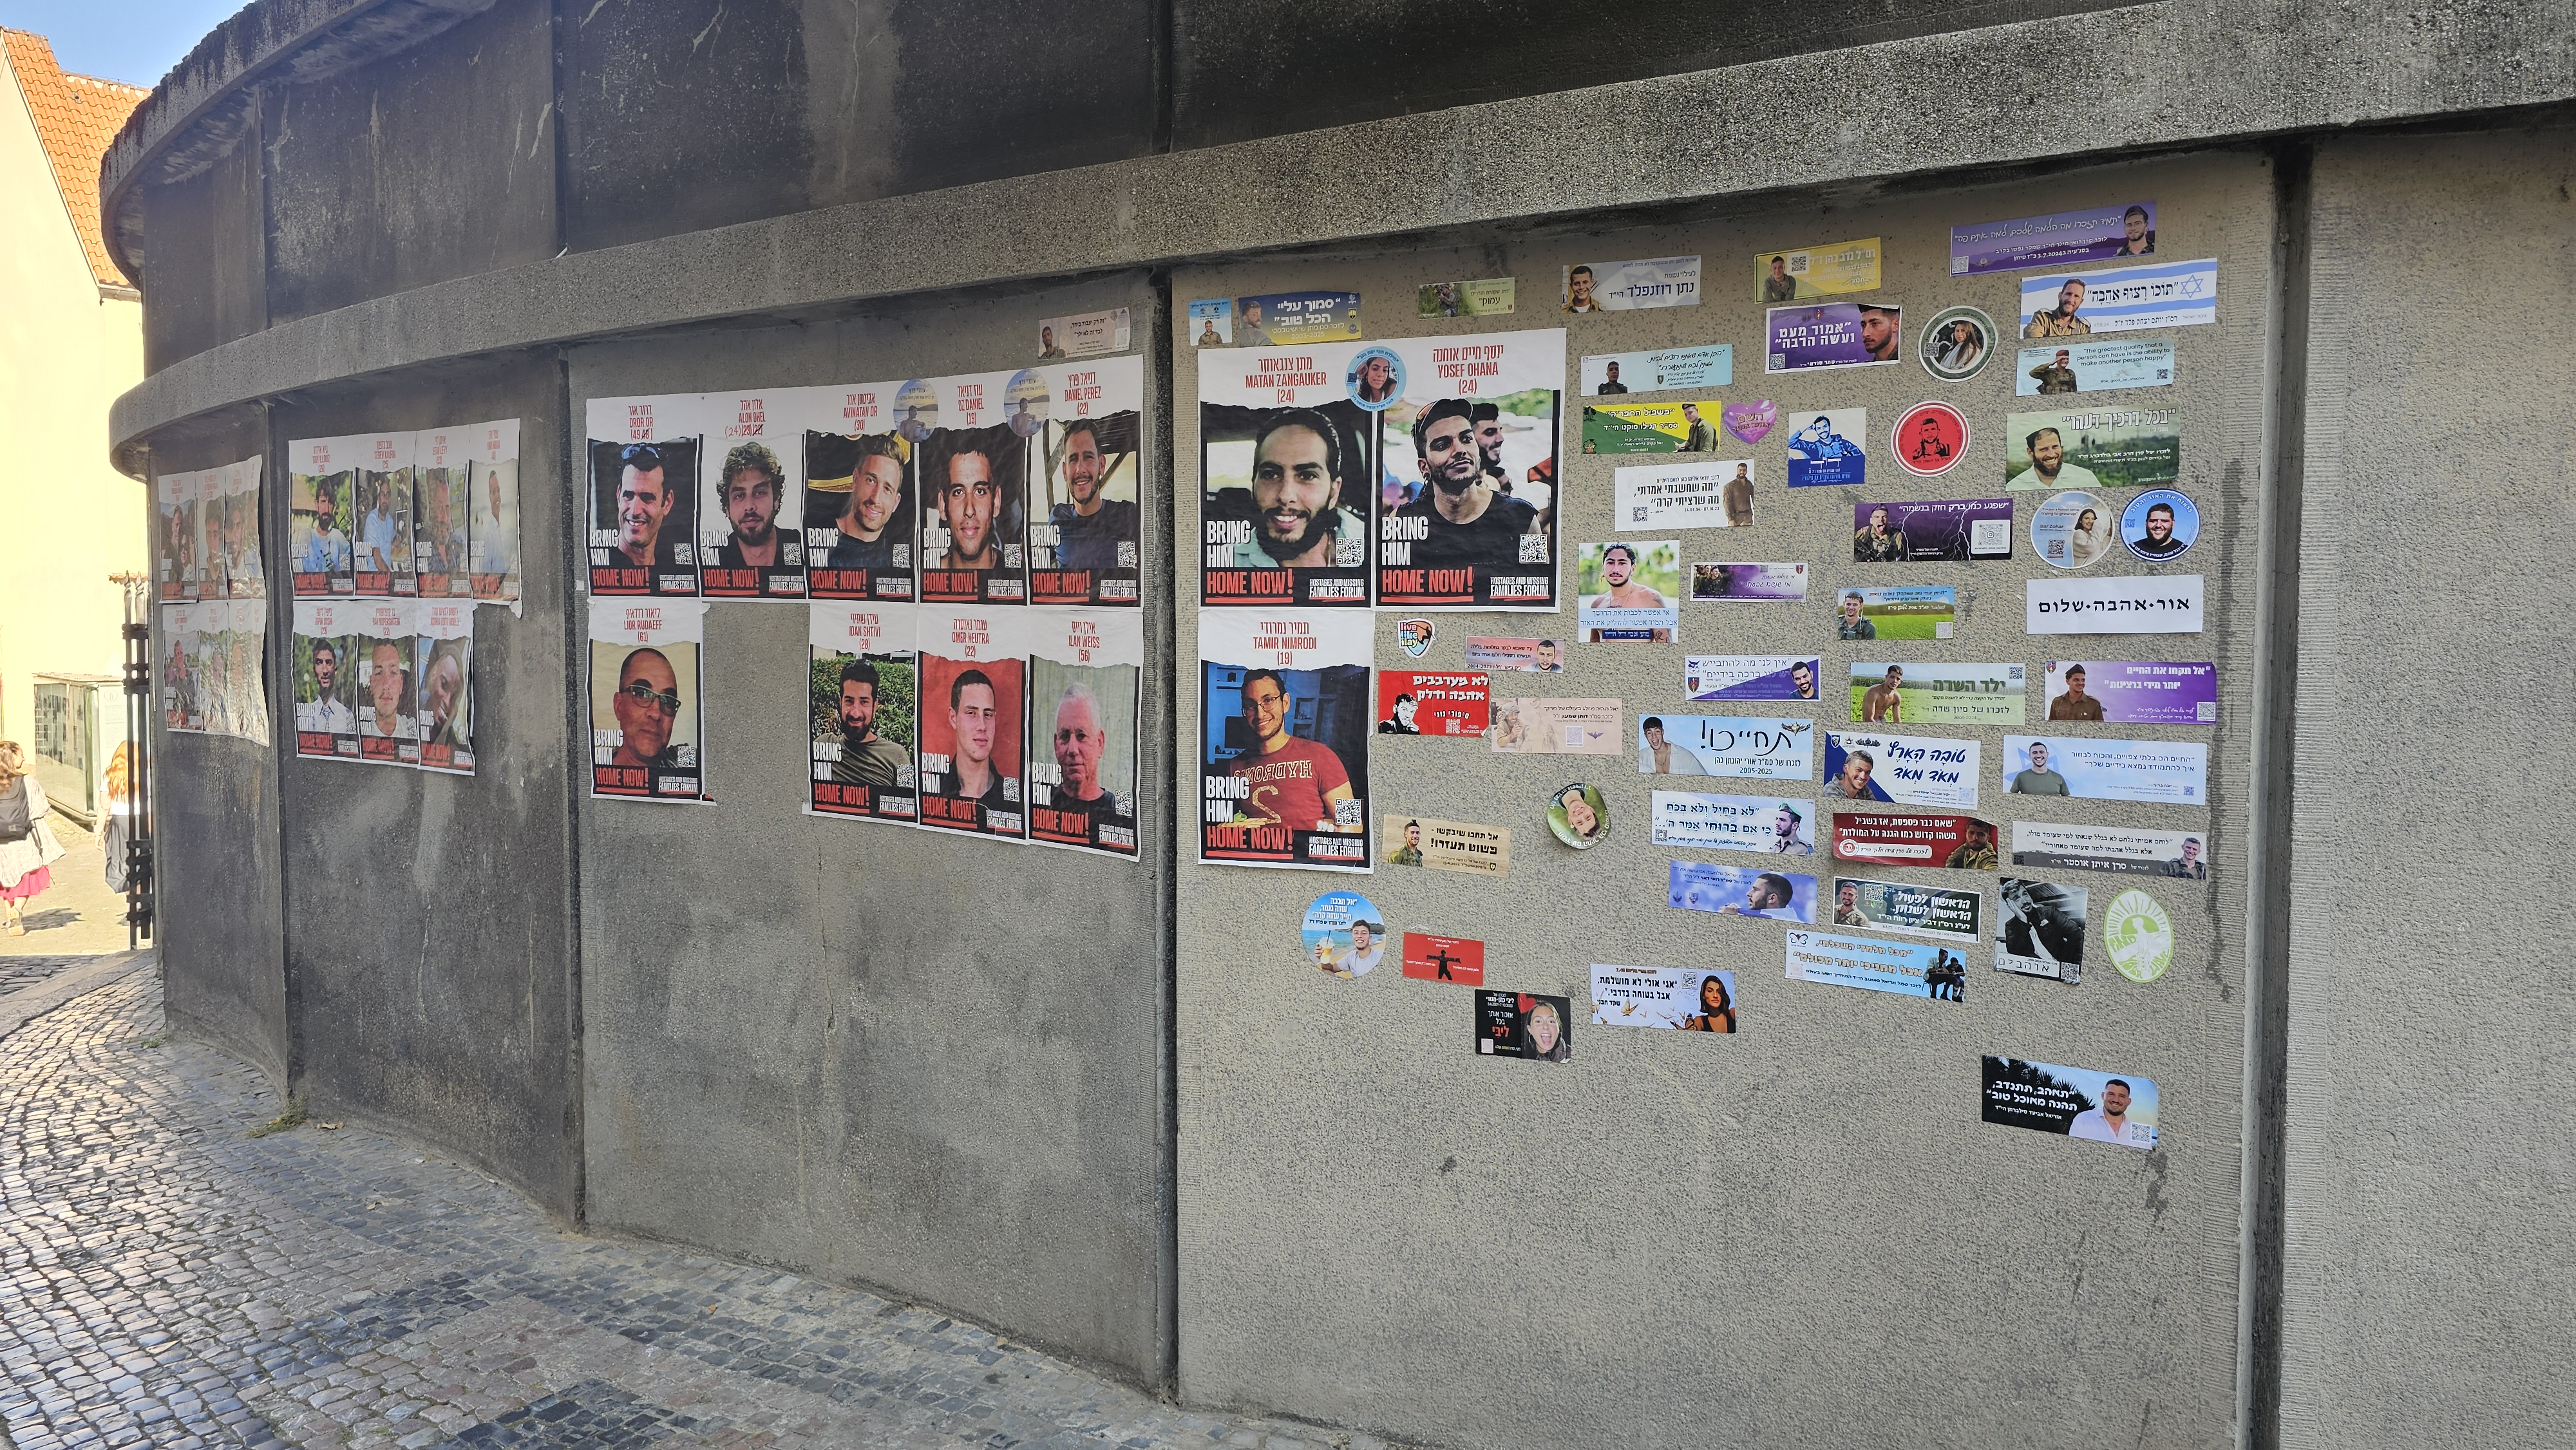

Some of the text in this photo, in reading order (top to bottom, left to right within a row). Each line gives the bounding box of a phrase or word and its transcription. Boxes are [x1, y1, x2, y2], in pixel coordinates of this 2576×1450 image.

[1627, 284, 1671, 297] רוזנפלד
[1676, 282, 1694, 296] נתן
[1277, 301, 1301, 312] עליי
[1305, 313, 1331, 324] הכל
[1779, 327, 1806, 337] מעט
[1821, 334, 1855, 345] ועשה
[1433, 344, 1504, 362] יוסף חיים אוחנה
[1258, 357, 1312, 372] מתן צנגאוקר
[1437, 362, 1499, 378] YOSEF OHANA
[1245, 372, 1326, 388] MATAN ZANGAUKER
[1459, 379, 1477, 395] (24)
[1065, 386, 1101, 402] DANIEL PEREZ
[1277, 388, 1294, 404] (24)
[1077, 402, 1088, 416] (22)
[629, 417, 653, 428] DROR OR
[738, 411, 766, 423] ALON OHEL
[1738, 413, 1763, 423] השם
[1664, 484, 1699, 493] שחשבתי
[1708, 496, 1719, 504] מה
[1206, 520, 1251, 543] BRING
[292, 543, 308, 558] BRING
[1206, 545, 1235, 568] HIM
[293, 558, 305, 572] HIM
[1206, 569, 1294, 594] HOME NOW!
[1309, 586, 1365, 598] FAMILIES FORUM
[624, 620, 662, 630] LIOR RUDAEFF
[1260, 622, 1309, 635] תמיר נמרודי
[1400, 623, 1417, 632] live
[638, 631, 648, 643] (61)
[952, 631, 990, 645] OMER NEUTRA
[1401, 630, 1417, 639] like
[1253, 636, 1317, 650] TAMIR NIMRODI
[1277, 652, 1293, 666] (19)
[2168, 666, 2190, 677] תקחו
[1413, 676, 1489, 686] לא מערבבים
[1933, 678, 2005, 692] ילד השדה
[1416, 690, 1484, 701] אהבה ודלק
[1855, 816, 1877, 825] בשביל
[1437, 827, 1466, 836] שיבקשו
[1431, 838, 1497, 854] פשוט תעזרו!
[1645, 979, 1660, 987] אולי
[2014, 1093, 2045, 1106] מאוכל
[2049, 1100, 2078, 1111] תהנה
